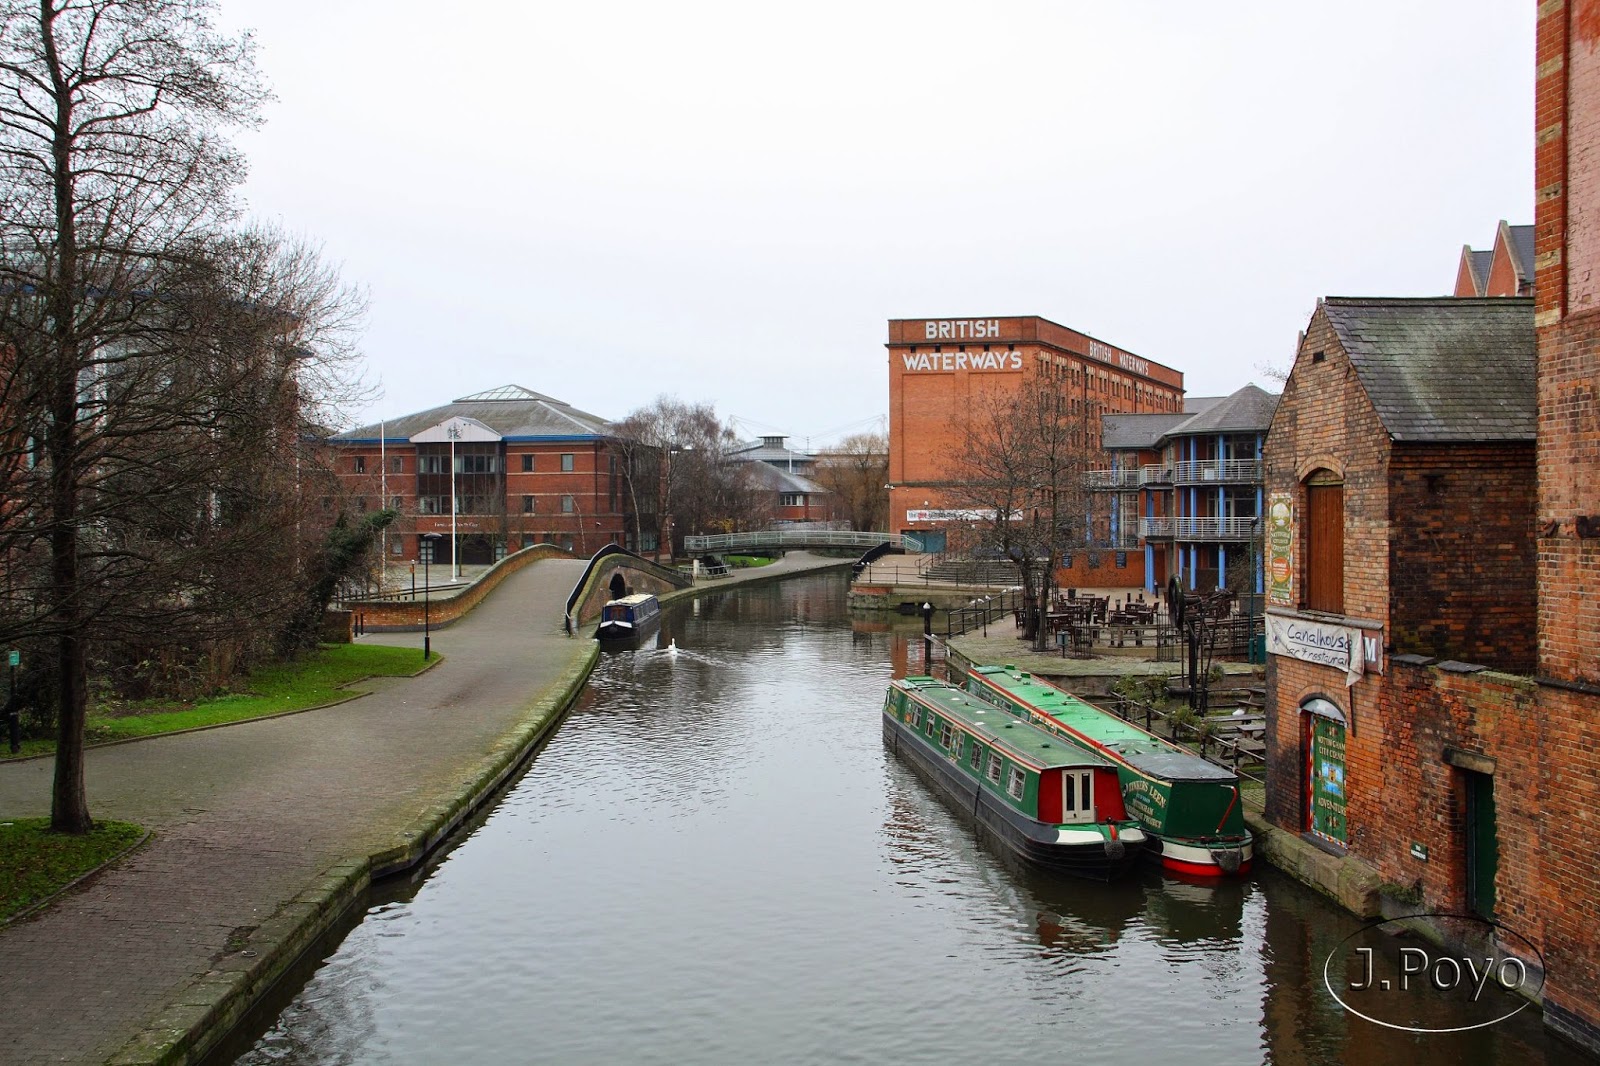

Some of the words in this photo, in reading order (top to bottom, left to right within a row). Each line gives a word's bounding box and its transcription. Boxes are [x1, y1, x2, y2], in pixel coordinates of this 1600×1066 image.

[925, 319, 1000, 340] BRITISH
[902, 350, 1023, 372] WATERWAYS
[1089, 340, 1112, 364] BRITISH
[1118, 351, 1149, 376] WATERWAYS
[1285, 644, 1300, 657] bar
[1319, 746, 1329, 756] CITY
